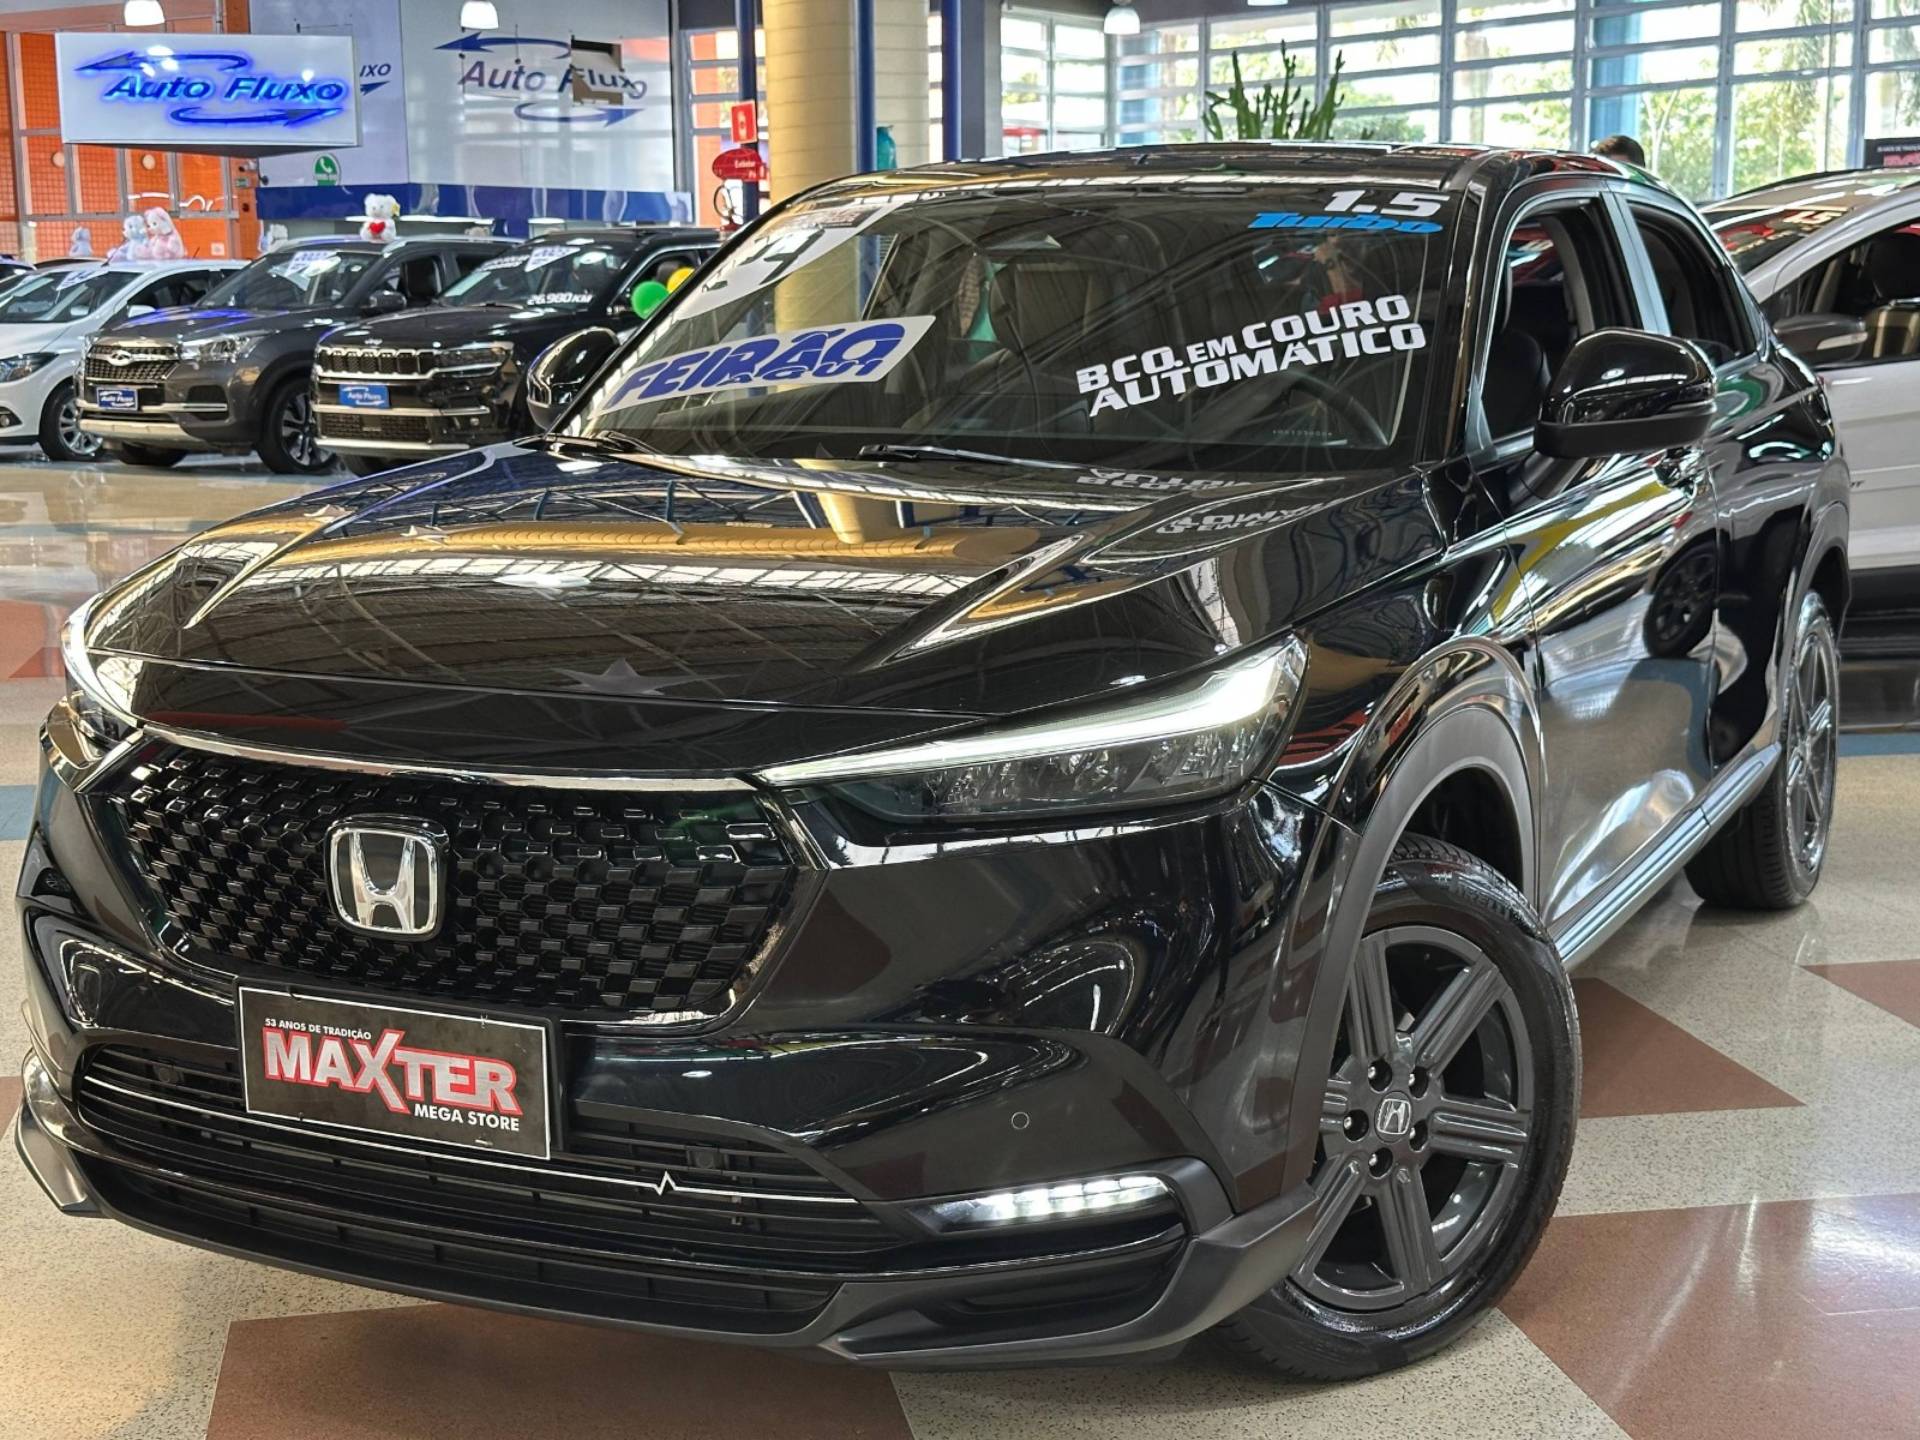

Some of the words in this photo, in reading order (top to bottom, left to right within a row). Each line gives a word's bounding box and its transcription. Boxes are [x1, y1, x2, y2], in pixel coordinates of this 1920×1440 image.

[104, 75, 212, 99] Auto
[223, 76, 345, 101] Fluxo
[458, 60, 546, 91] Auto
[1324, 189, 1450, 217] 1.5
[1247, 212, 1444, 234] Turbo
[1186, 335, 1238, 364] EM
[1242, 294, 1411, 349] COURO
[604, 323, 905, 409] FEIRÃO
[1089, 323, 1426, 418] AUTOMÁTICO
[265, 1018, 277, 1027] 53
[278, 1020, 306, 1031] ANOS
[308, 1023, 321, 1034] DE
[323, 1025, 372, 1041] TRADIÇÃO
[262, 1027, 523, 1115] MAXTER
[414, 1103, 463, 1124] MEGA
[467, 1112, 521, 1132] STORE
